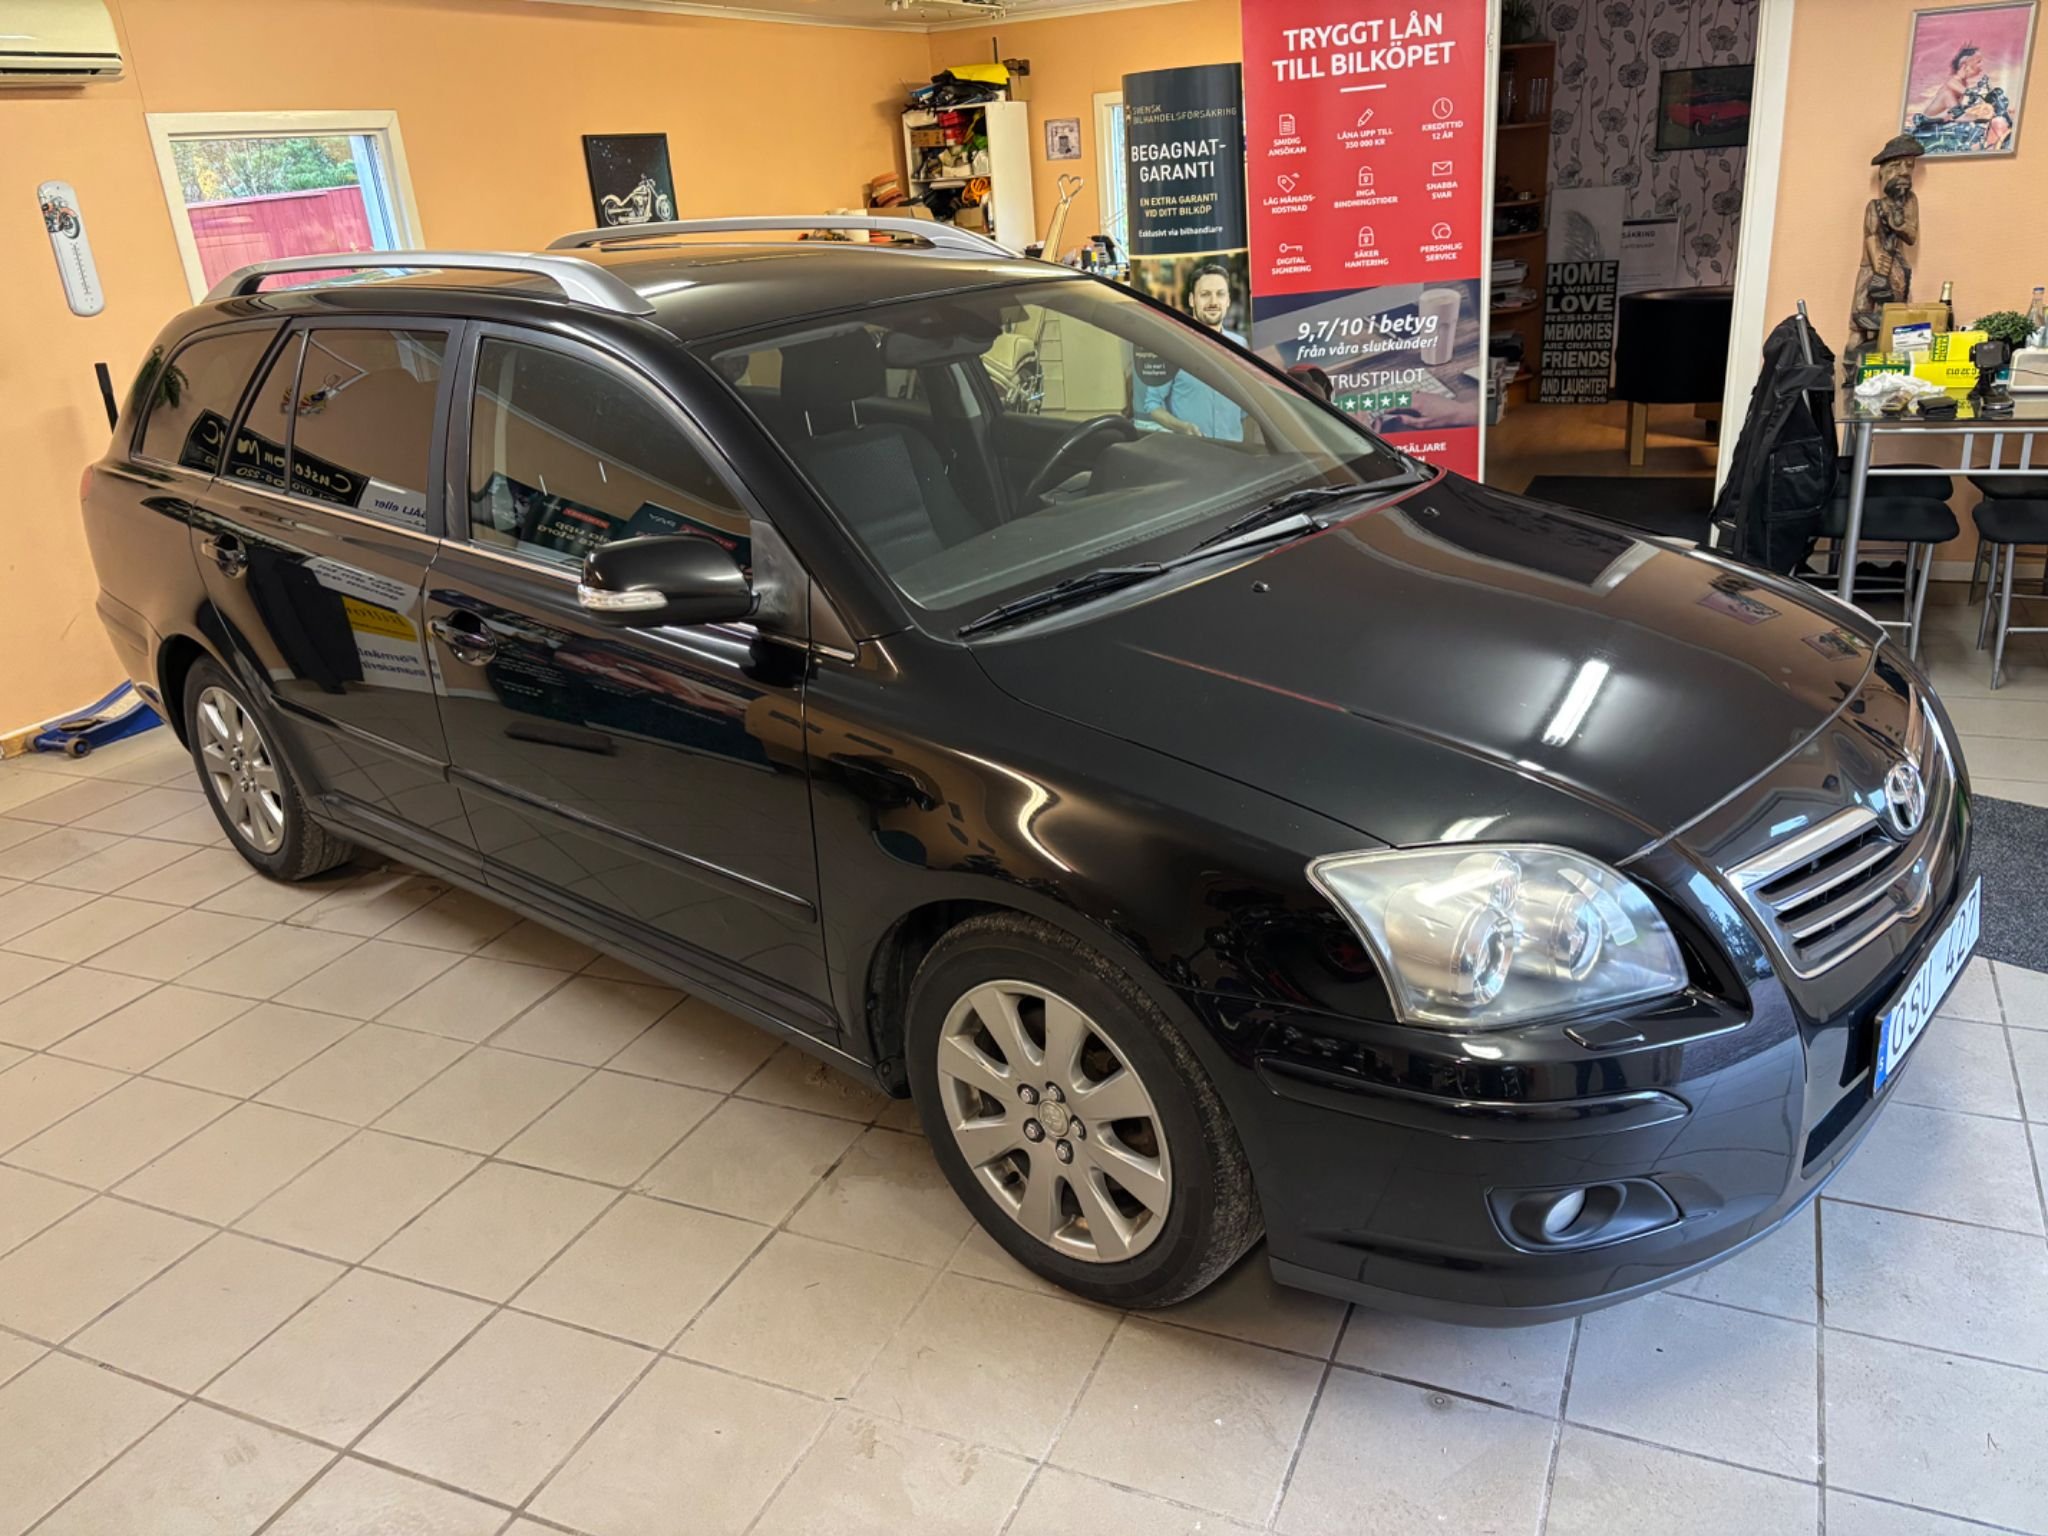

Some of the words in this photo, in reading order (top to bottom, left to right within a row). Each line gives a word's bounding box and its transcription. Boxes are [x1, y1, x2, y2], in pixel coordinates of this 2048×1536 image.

[1283, 20, 1384, 52] TRYGGT
[1389, 10, 1443, 41] LÅN
[1272, 56, 1325, 82] TILL
[1331, 41, 1456, 76] BILKÖPET
[1132, 104, 1162, 115] SVENSK
[1273, 137, 1301, 147] SMIDIG
[1131, 138, 1226, 163] BEGAGNAT-
[1139, 161, 1215, 183] GARANTI
[1426, 181, 1459, 191] SNABBA
[1151, 195, 1177, 206] EXTRA
[1178, 192, 1218, 204] GARANTI
[1356, 189, 1376, 198] INGA
[1431, 190, 1453, 200] SVAR
[1144, 208, 1157, 217] VID
[1158, 207, 1177, 216] DITT
[1271, 204, 1308, 215] KOSTNAD
[1168, 228, 1178, 236] via
[1420, 242, 1463, 253] PERSONLIG
[1276, 256, 1306, 266] DIGITAL
[1425, 252, 1457, 262] SERVICE
[1345, 258, 1389, 268] HANTERING
[1271, 265, 1312, 275] SIGNERING
[1547, 262, 1617, 285] HOME
[1562, 284, 1615, 293] WHERE
[1546, 294, 1614, 313] LOVE
[1297, 317, 1364, 343] 9,7/10
[1367, 315, 1376, 330] i
[1379, 313, 1439, 335] betyg
[1544, 322, 1612, 341] MEMORIES
[1296, 343, 1326, 361] från
[1329, 341, 1359, 356] våra
[1362, 336, 1438, 353] slutkunder!
[1565, 341, 1611, 349] CREATED
[1542, 350, 1610, 368] FRIENDS
[1328, 368, 1425, 389] TRUSTPILOT
[1540, 378, 1560, 395] AND
[1561, 377, 1608, 394] LAUGHTER
[1892, 959, 1933, 1055] OSU
